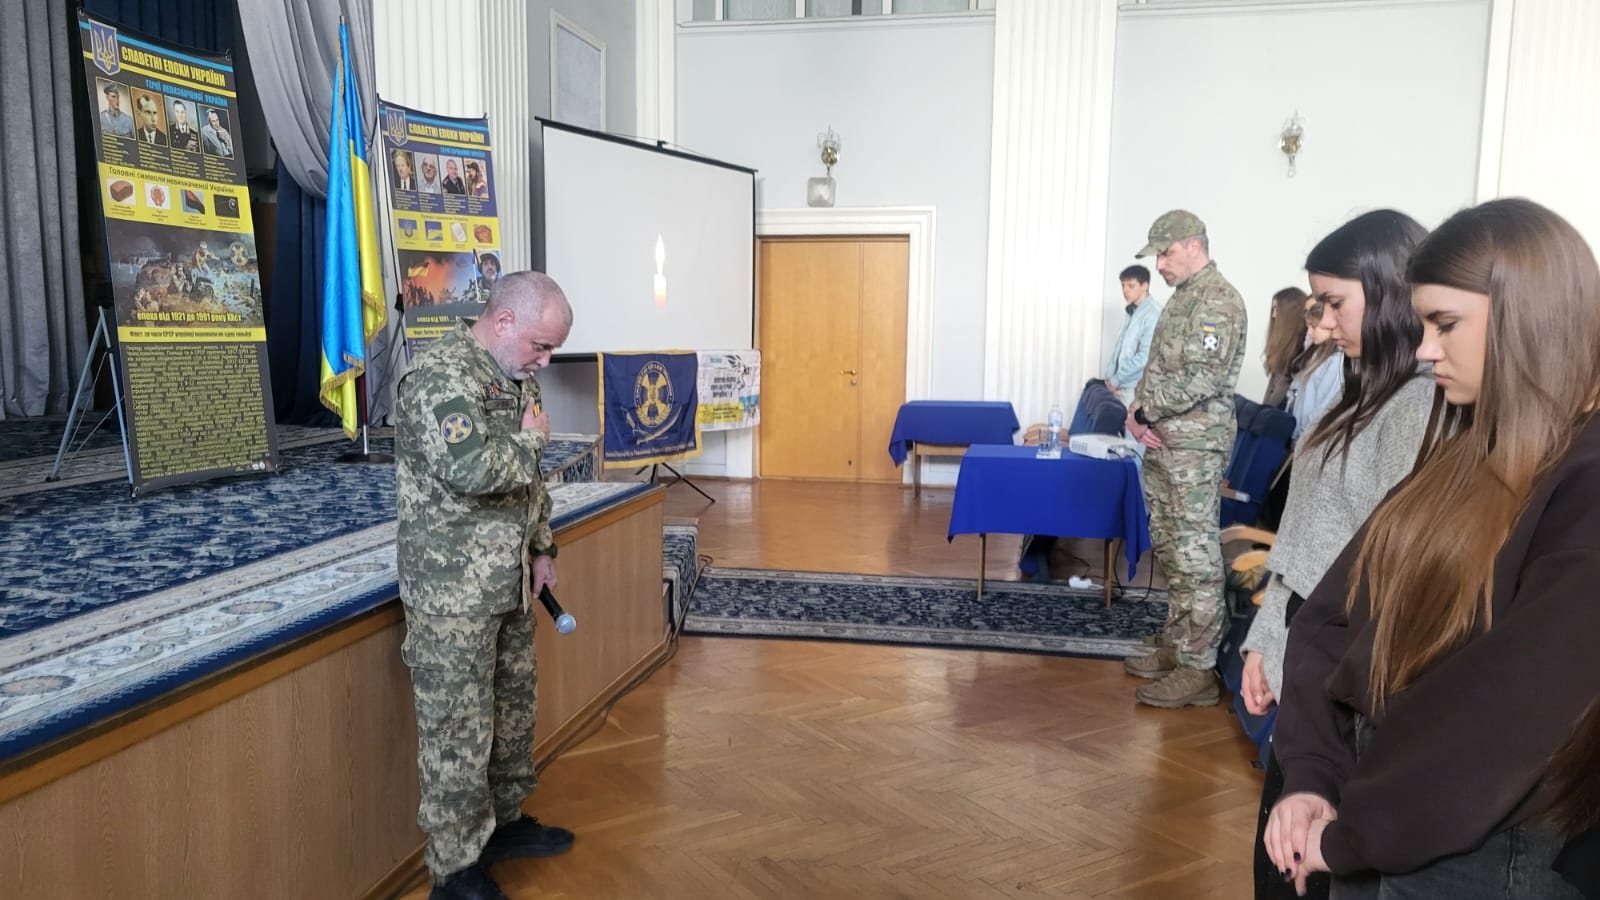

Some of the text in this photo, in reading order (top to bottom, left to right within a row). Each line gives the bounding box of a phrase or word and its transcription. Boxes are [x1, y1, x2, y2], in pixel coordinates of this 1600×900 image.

[121, 46, 226, 87] СЛАВЕТНІ ЕПОХИ УКРАЇНИ
[459, 131, 485, 144] УКРАЇНИ
[109, 167, 136, 177] Головні
[136, 172, 165, 183] символи
[209, 183, 234, 193] України
[186, 313, 196, 322] до
